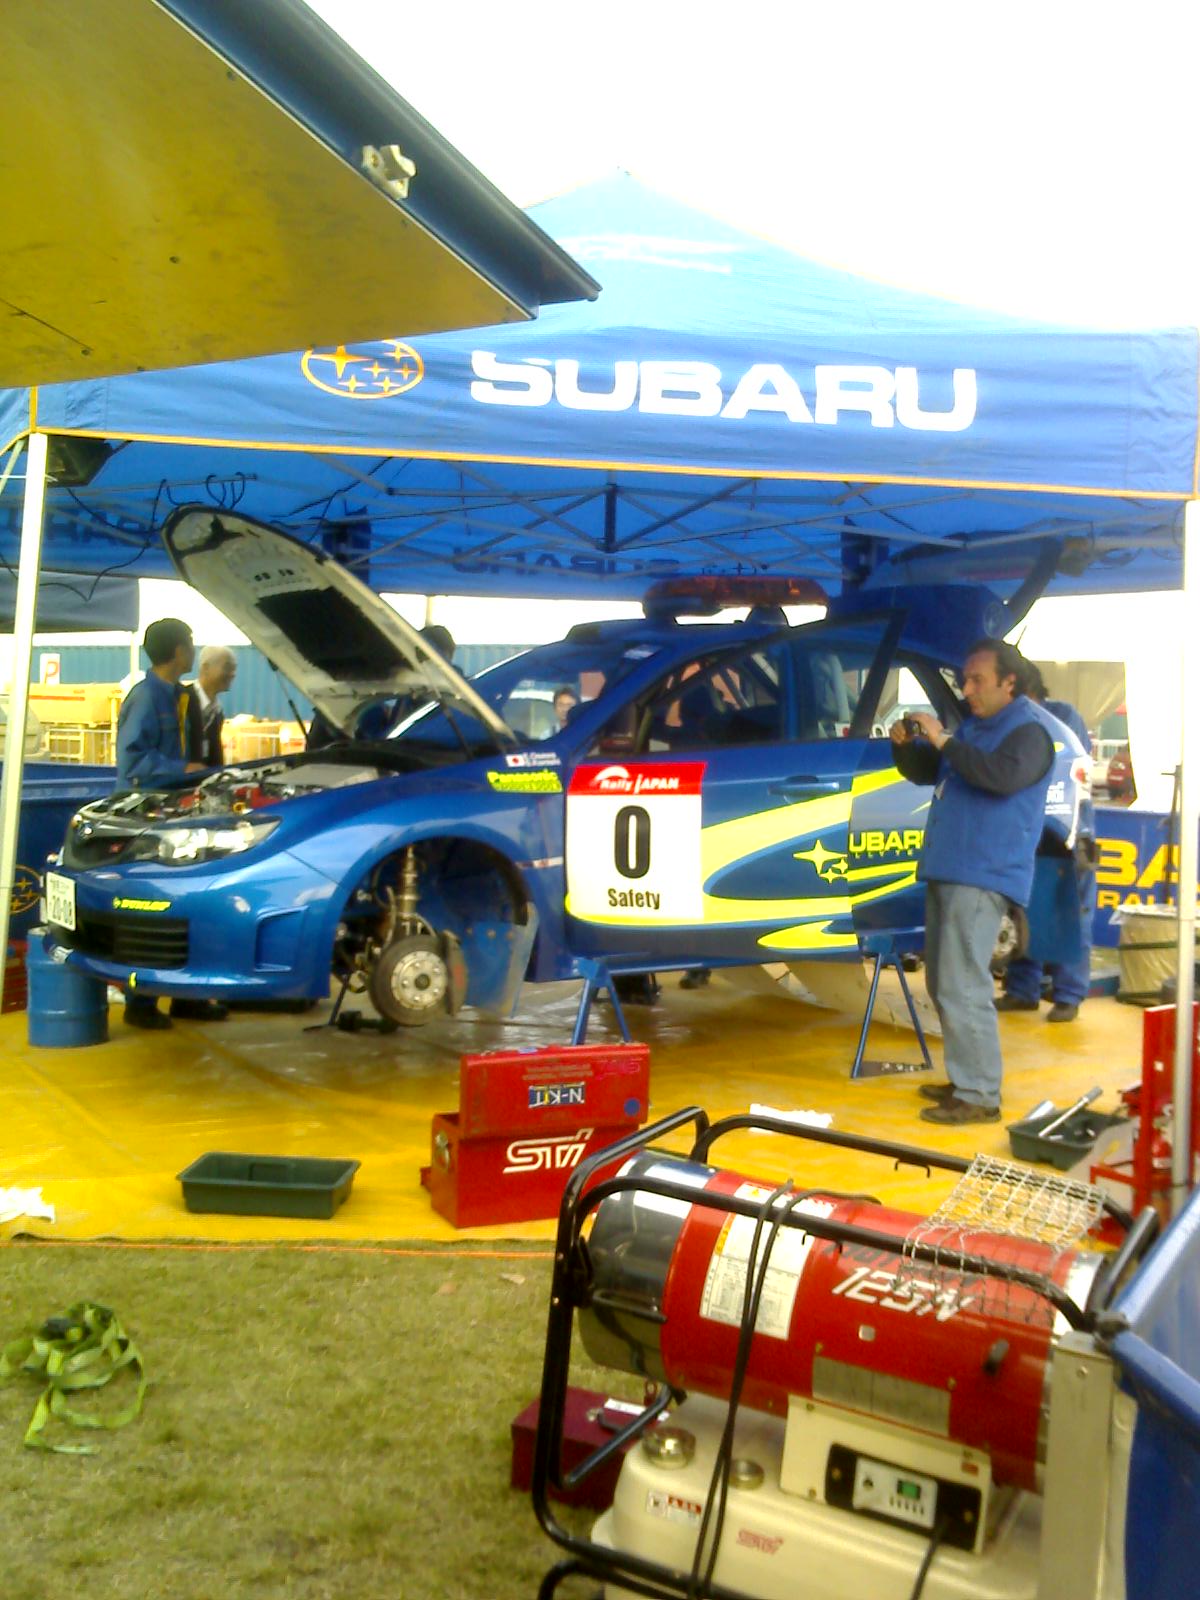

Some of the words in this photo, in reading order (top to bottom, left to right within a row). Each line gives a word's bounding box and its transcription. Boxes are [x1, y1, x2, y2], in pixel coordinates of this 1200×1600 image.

[471, 350, 977, 432] SUBARU
[615, 805, 650, 879] 0
[849, 830, 925, 852] UBAR
[608, 889, 660, 910] Safety
